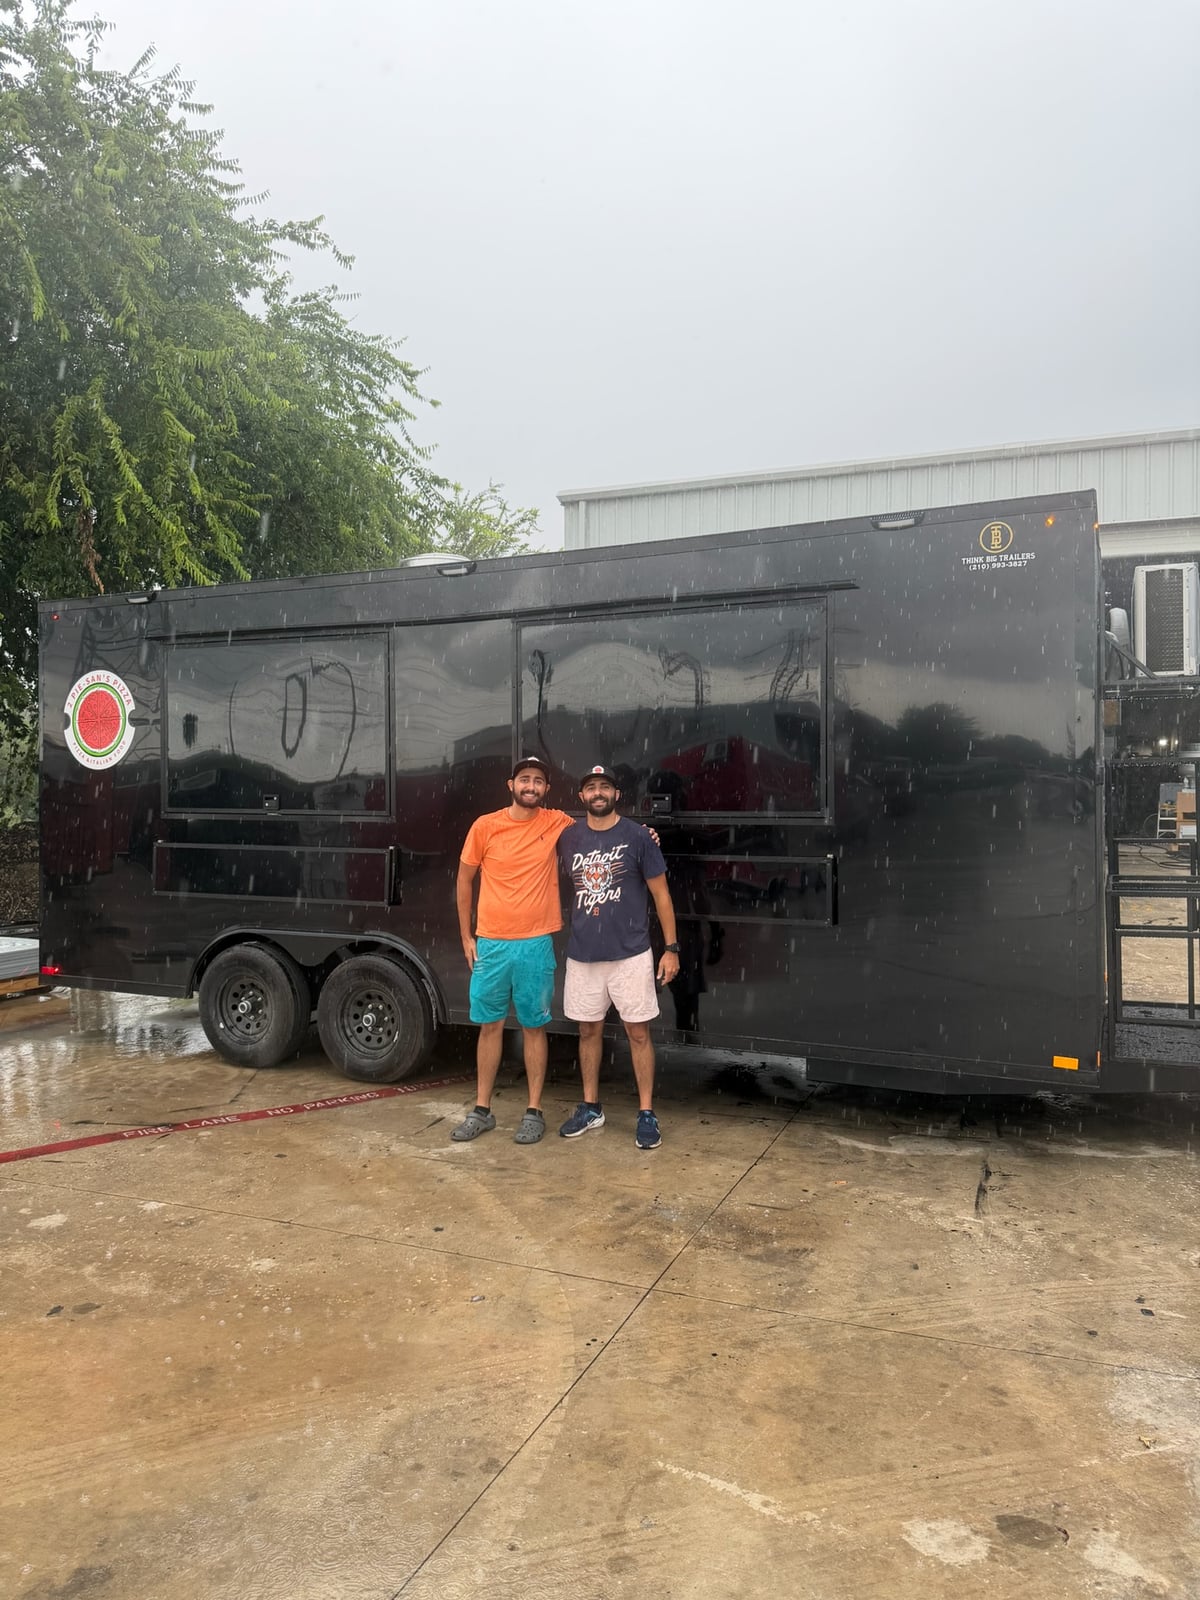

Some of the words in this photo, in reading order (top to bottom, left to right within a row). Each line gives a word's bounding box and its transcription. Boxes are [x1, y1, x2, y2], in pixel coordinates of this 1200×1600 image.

[961, 556, 984, 565] THINK
[986, 555, 998, 563] BIG
[999, 552, 1036, 562] TRAILERS
[969, 563, 990, 571] (210)
[112, 679, 132, 706] PIZZA
[571, 844, 629, 871] Detroit
[576, 886, 622, 914] Tigers
[122, 1125, 174, 1138] FIRE
[183, 1115, 241, 1129] LANE
[266, 1106, 294, 1116] NO
[303, 1091, 380, 1110] PARKING
